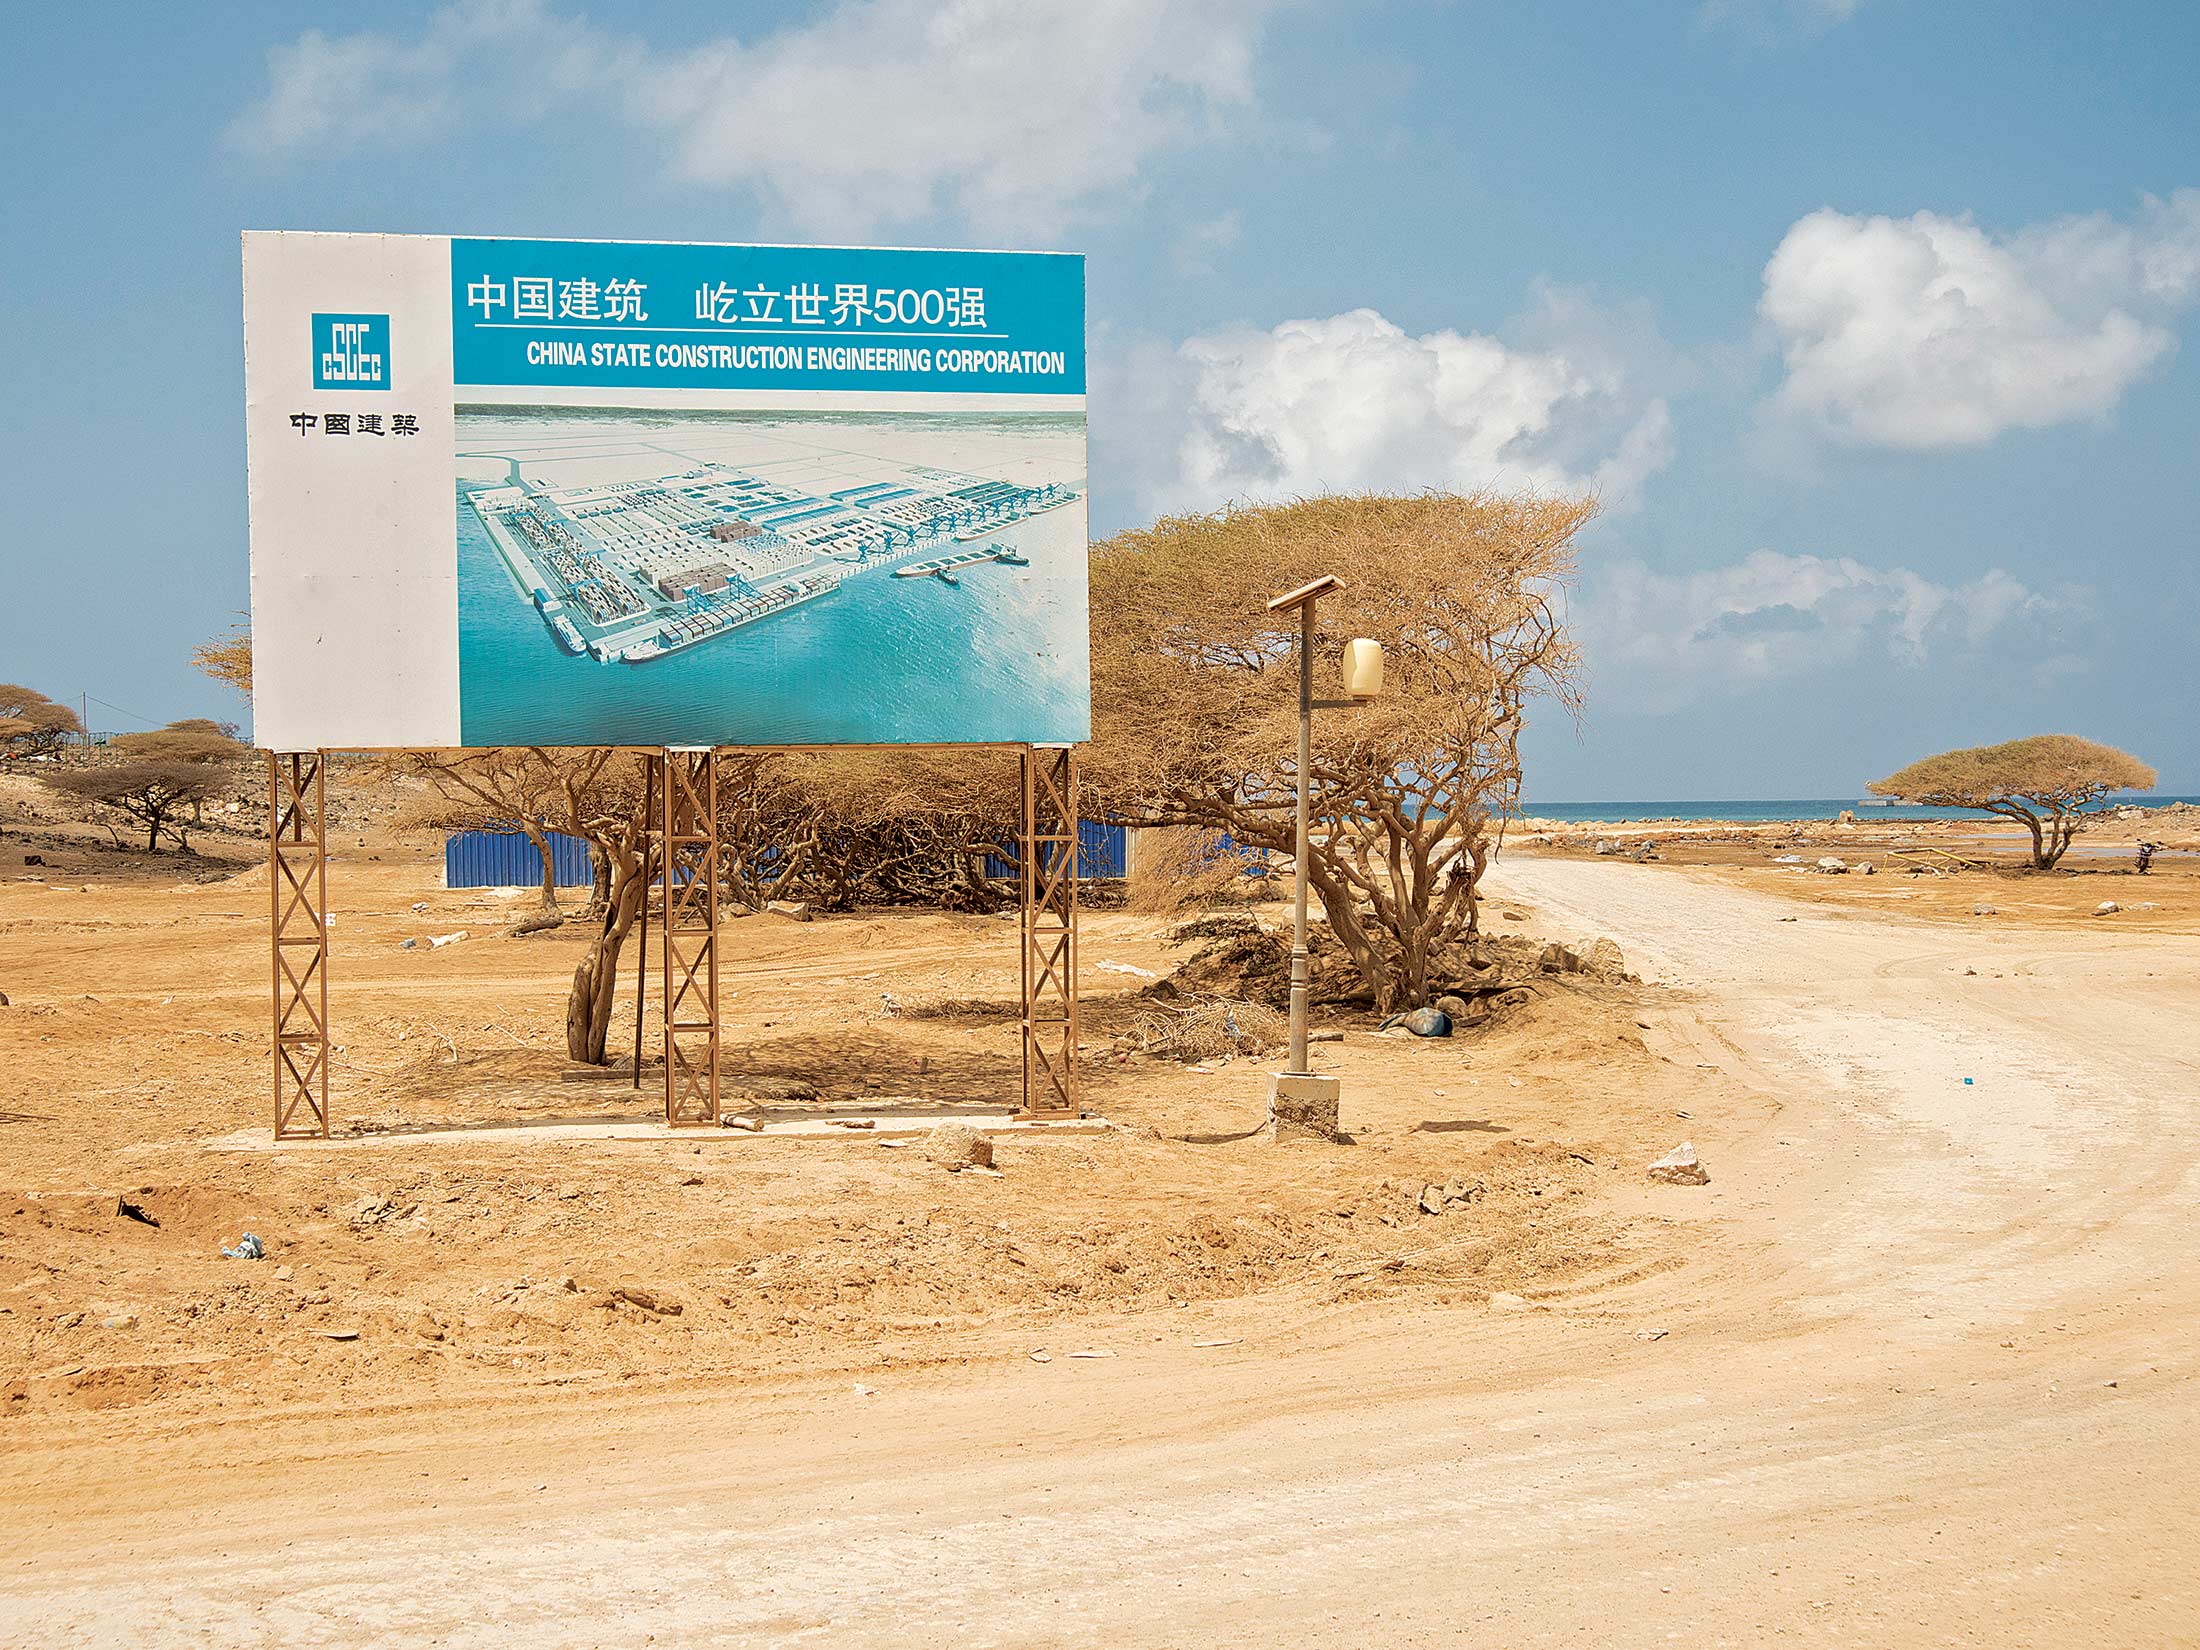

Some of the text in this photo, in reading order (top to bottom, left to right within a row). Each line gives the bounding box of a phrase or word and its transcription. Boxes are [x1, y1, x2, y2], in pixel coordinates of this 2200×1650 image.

[467, 274, 988, 329] 中国建筑 屹立世界500强
[526, 341, 1065, 375] CHINA STATE CONSTRUCTION ENGINEERING CORPORATION
